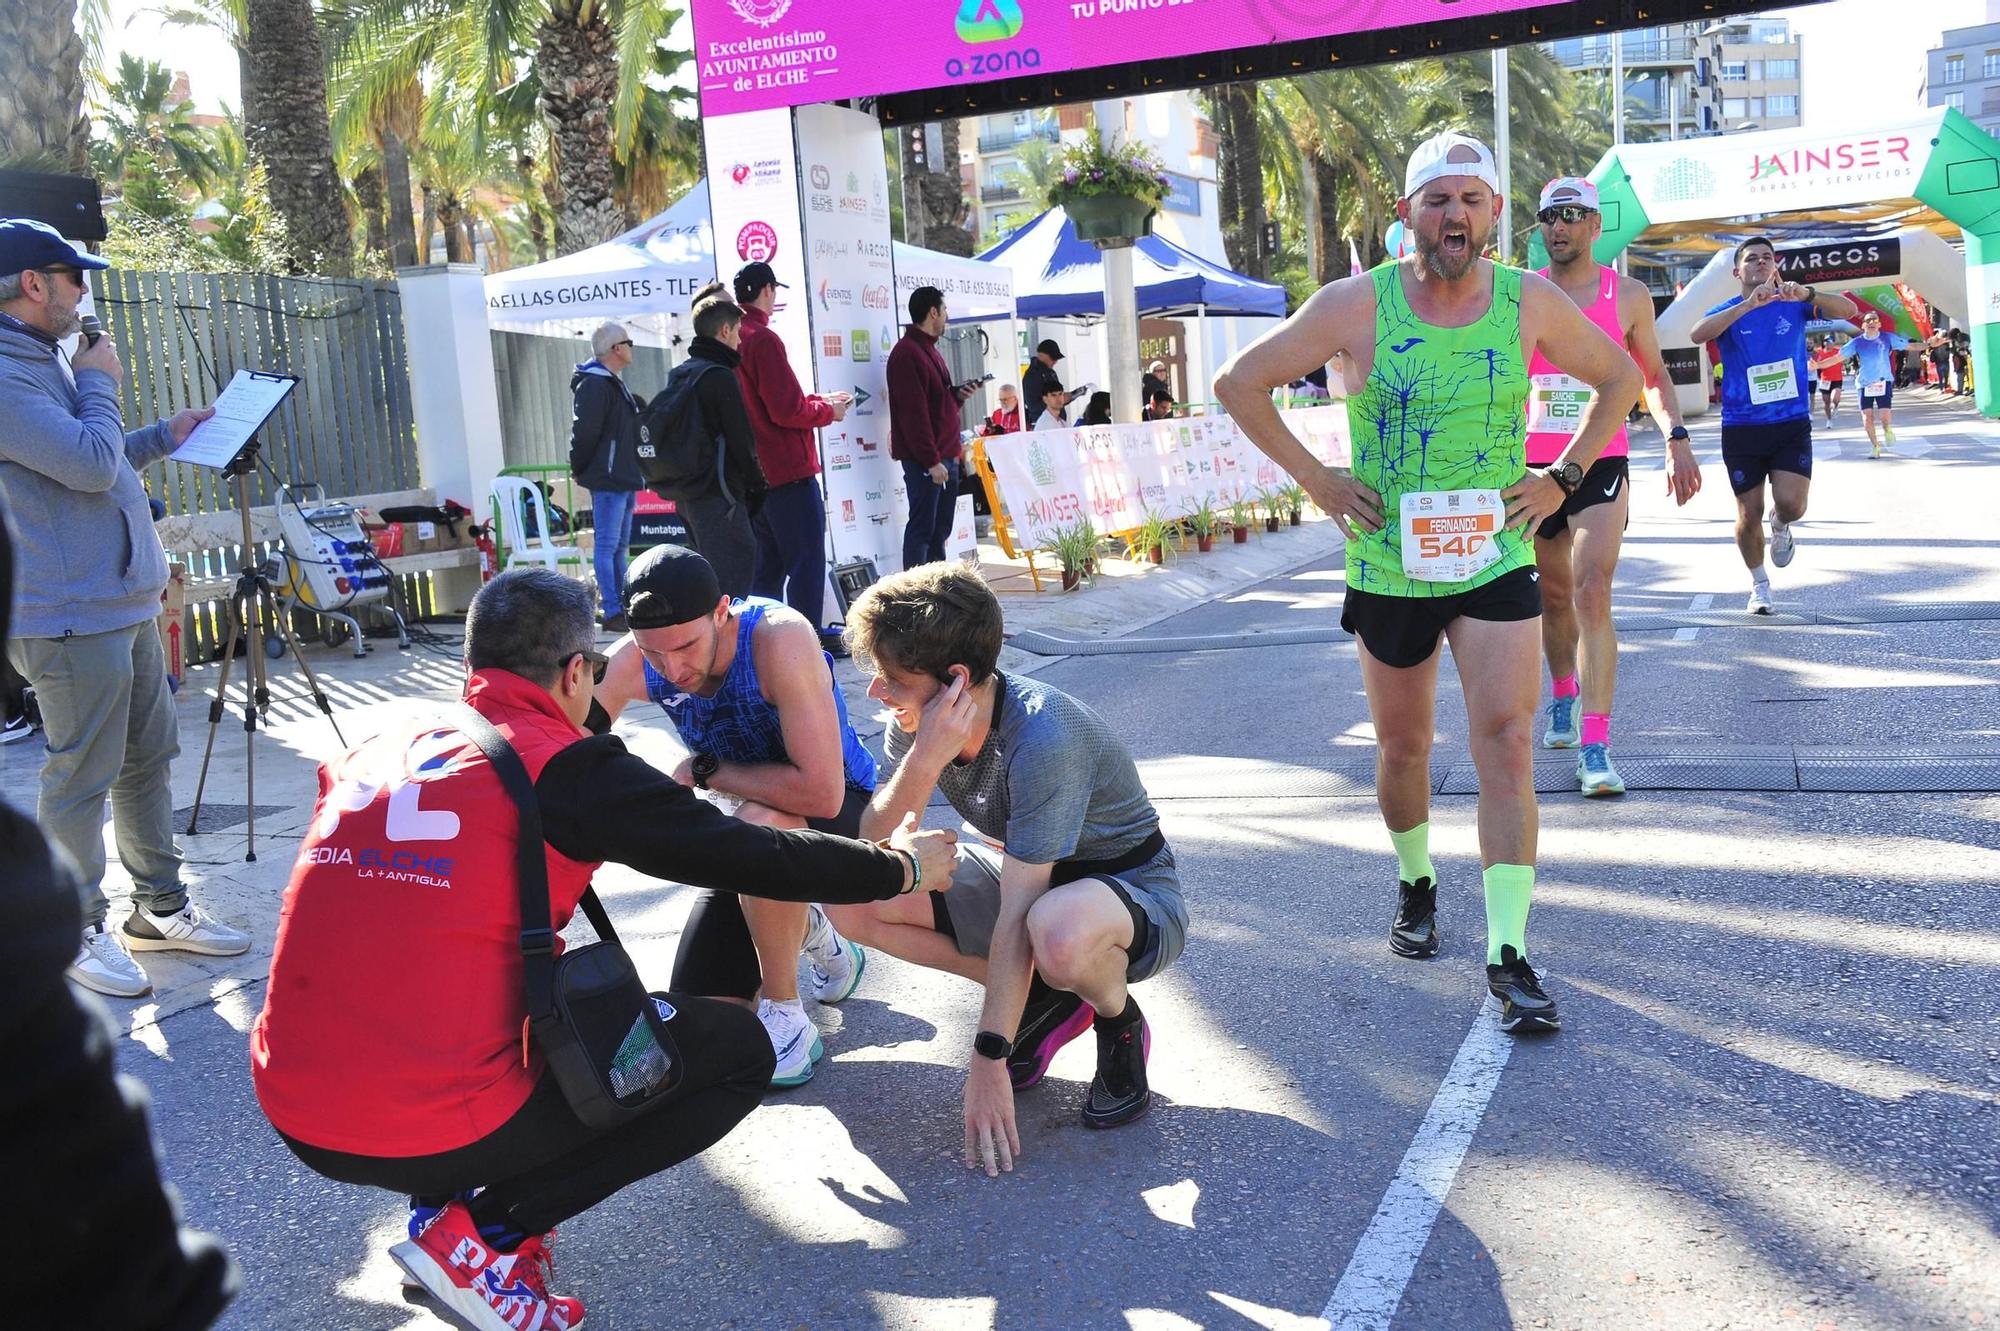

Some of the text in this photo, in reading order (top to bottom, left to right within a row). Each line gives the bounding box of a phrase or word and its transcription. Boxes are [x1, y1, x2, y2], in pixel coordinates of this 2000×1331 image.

[1071, 2, 1095, 19] TU
[709, 30, 826, 57] Excelentísimo
[702, 45, 837, 78] AYUNTAMIENTO
[733, 68, 809, 92] de ELCHE
[1749, 137, 1910, 181] JAINSER
[1750, 182, 1797, 193] OBRAS
[1826, 168, 1912, 185] SERVICIOS
[1775, 247, 1880, 272] MARCOS
[486, 290, 555, 308] AELLAS
[557, 279, 651, 304] GIGANTES
[1757, 379, 1787, 394] 397
[1545, 403, 1580, 417] 162
[1429, 518, 1478, 533] FERNANDO
[1420, 535, 1487, 559] 540
[358, 869, 374, 878] LA
[359, 847, 455, 877] ELCHE
